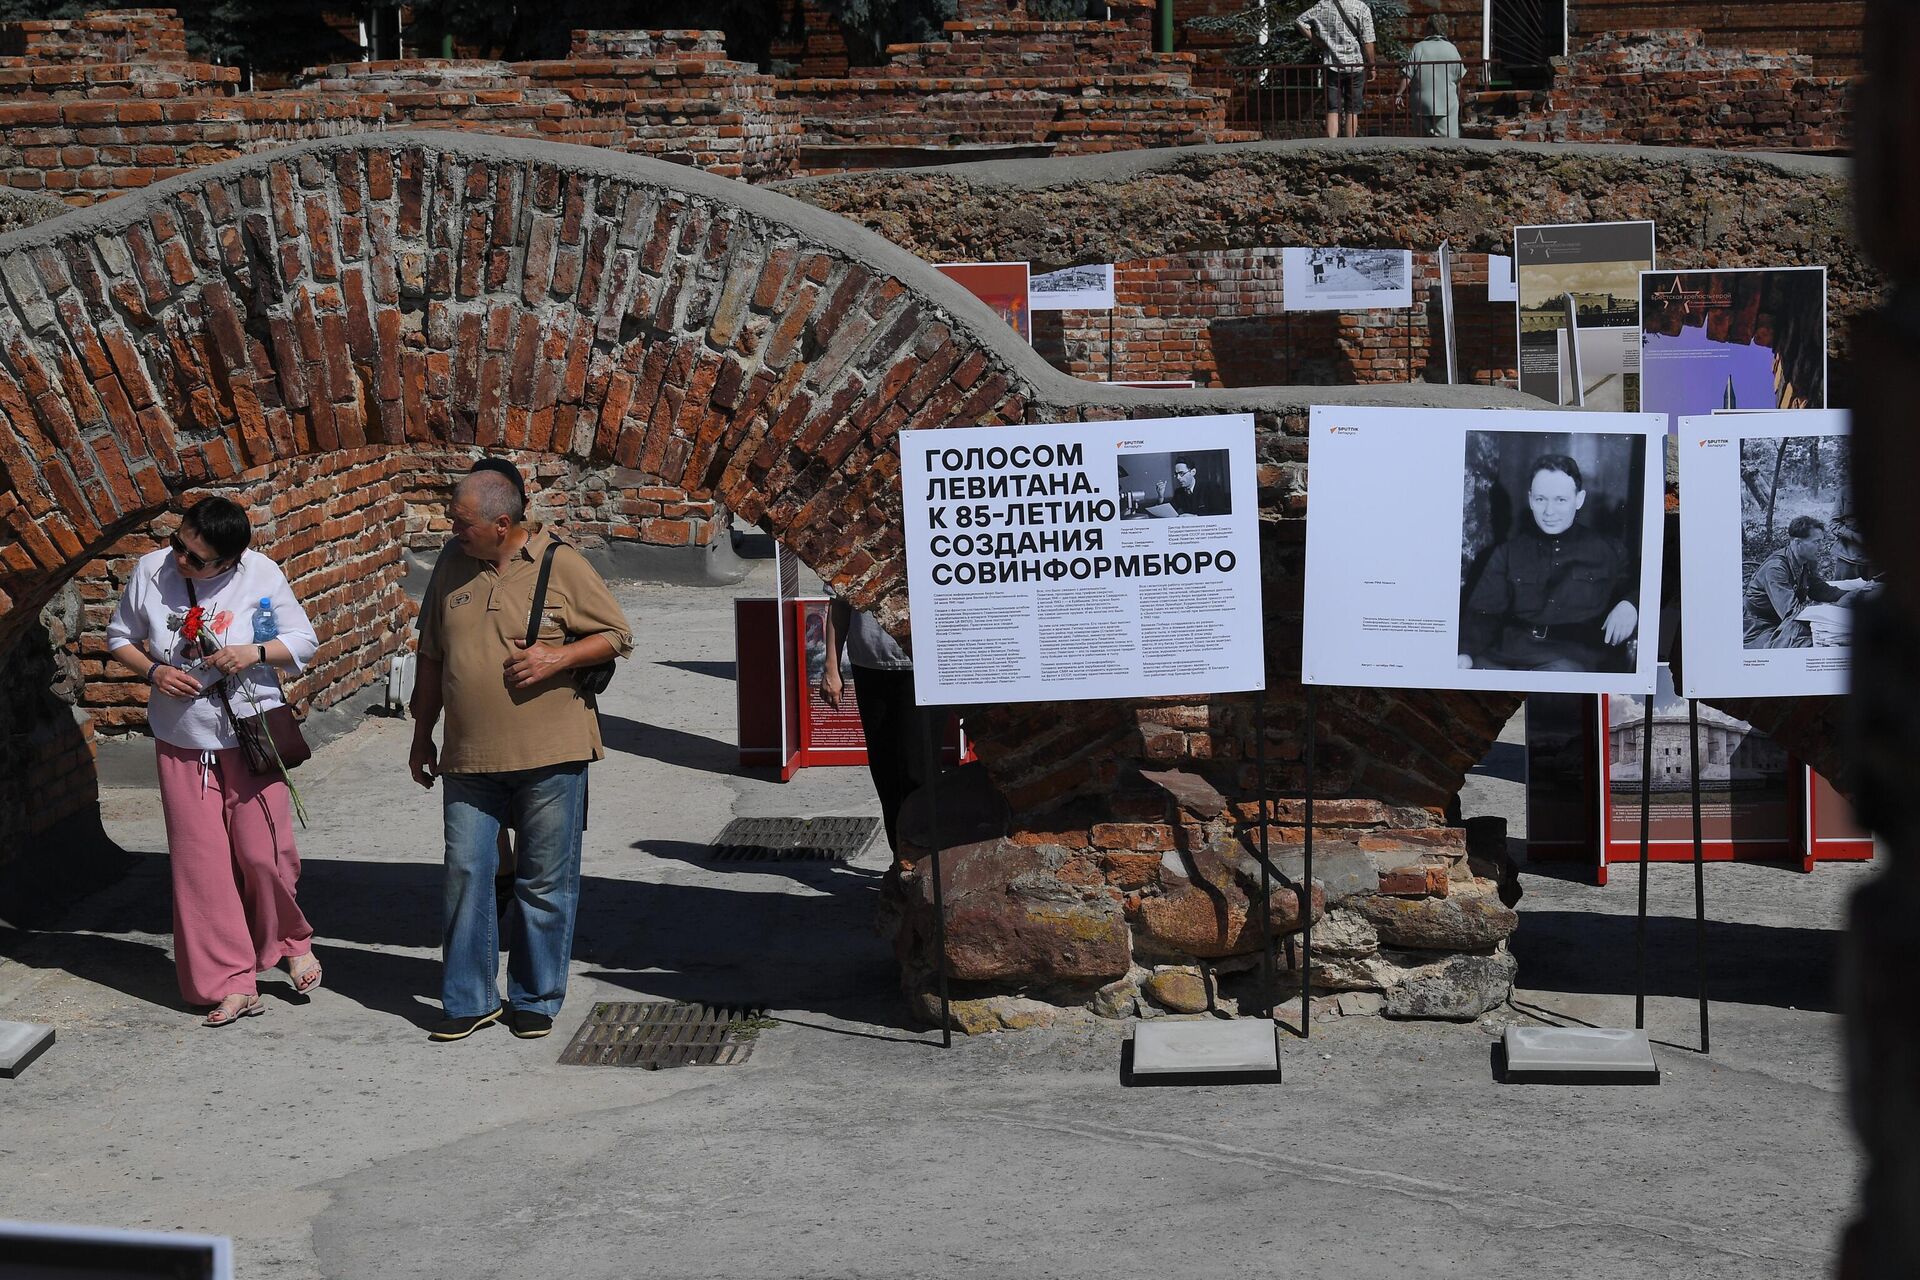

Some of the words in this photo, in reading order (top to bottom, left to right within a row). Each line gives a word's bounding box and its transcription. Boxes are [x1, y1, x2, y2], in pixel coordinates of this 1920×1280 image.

[926, 443, 1083, 472] ГОЛОСОМ
[926, 472, 1100, 500] ЛЕВИТАНА.
[929, 507, 948, 529] К
[955, 499, 1116, 528] 85-ЛЕТИЮ
[930, 528, 1103, 559] СОЗДАНИЯ
[932, 550, 1237, 586] СОВИНФОРМБЮРО
